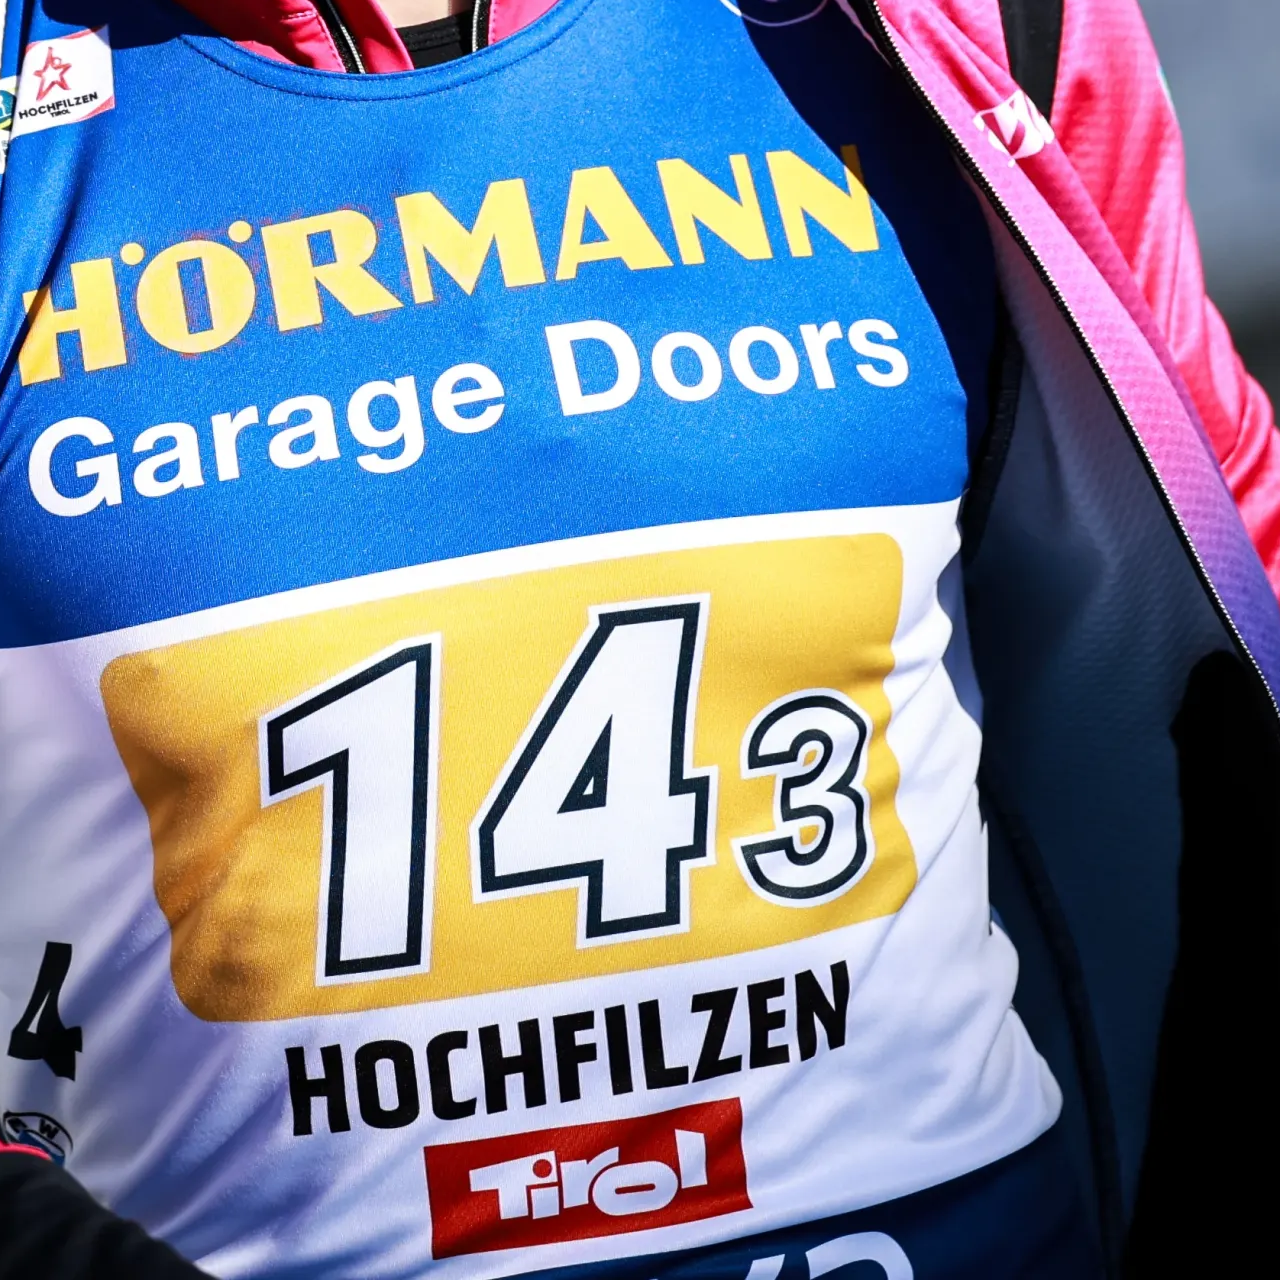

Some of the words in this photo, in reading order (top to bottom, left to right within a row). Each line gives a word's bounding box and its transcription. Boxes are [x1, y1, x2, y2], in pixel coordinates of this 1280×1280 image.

[18, 91, 99, 119] HOCHFILZEN
[18, 144, 879, 386] HÖRMANN
[28, 362, 506, 518] Garage
[544, 318, 909, 417] Doors
[7, 941, 83, 1082] 4
[284, 960, 850, 1137] HOCHFILZEN
